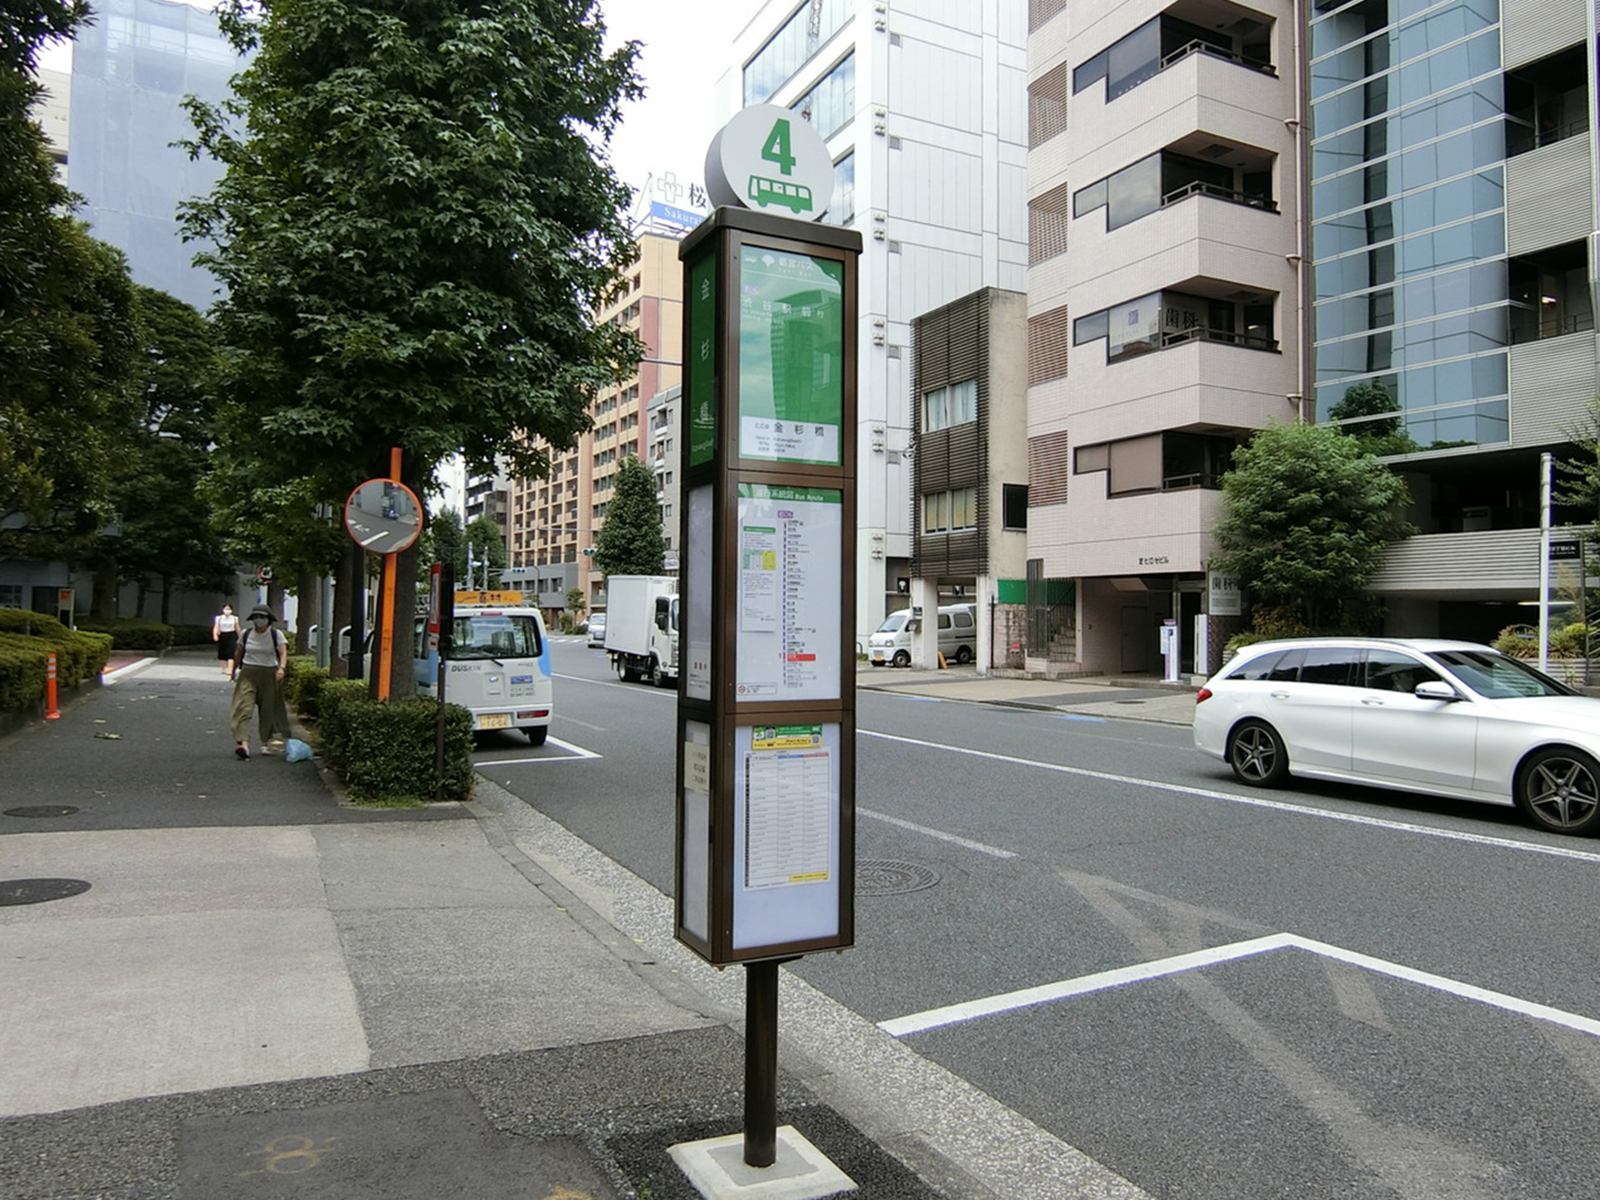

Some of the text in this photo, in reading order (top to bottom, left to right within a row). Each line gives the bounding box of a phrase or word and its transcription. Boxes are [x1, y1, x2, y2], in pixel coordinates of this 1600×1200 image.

[761, 118, 796, 176] 4
[688, 182, 707, 209] 桜
[1165, 307, 1199, 330] 歯科
[774, 422, 825, 437] 金杉橋
